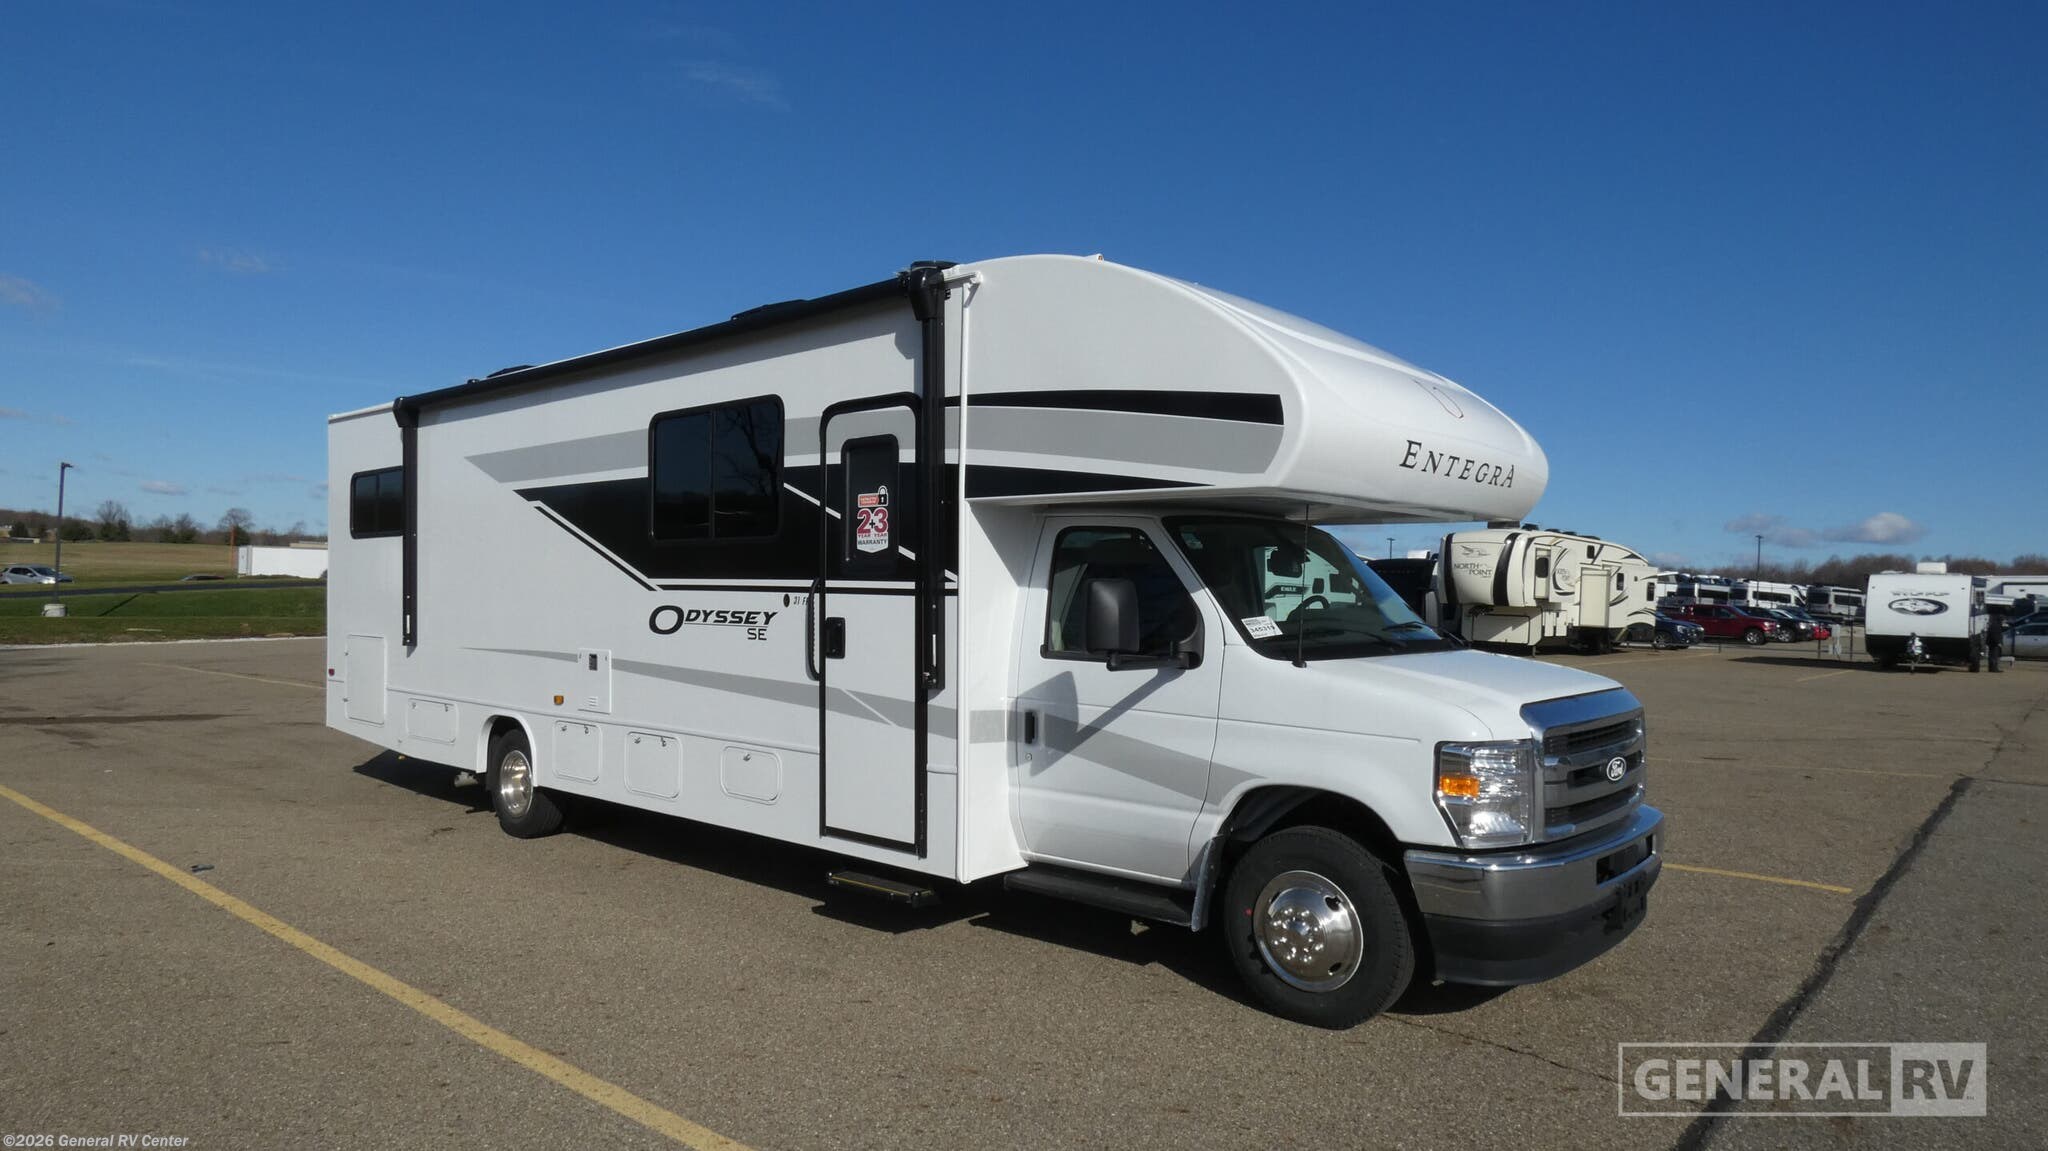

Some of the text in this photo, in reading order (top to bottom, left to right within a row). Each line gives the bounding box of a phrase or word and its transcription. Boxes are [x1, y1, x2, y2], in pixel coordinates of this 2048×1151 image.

[1399, 439, 1515, 488] ENTEGRA
[1468, 568, 1493, 576] POINT
[649, 604, 778, 636] ODYSSEY
[747, 628, 768, 641] SE
